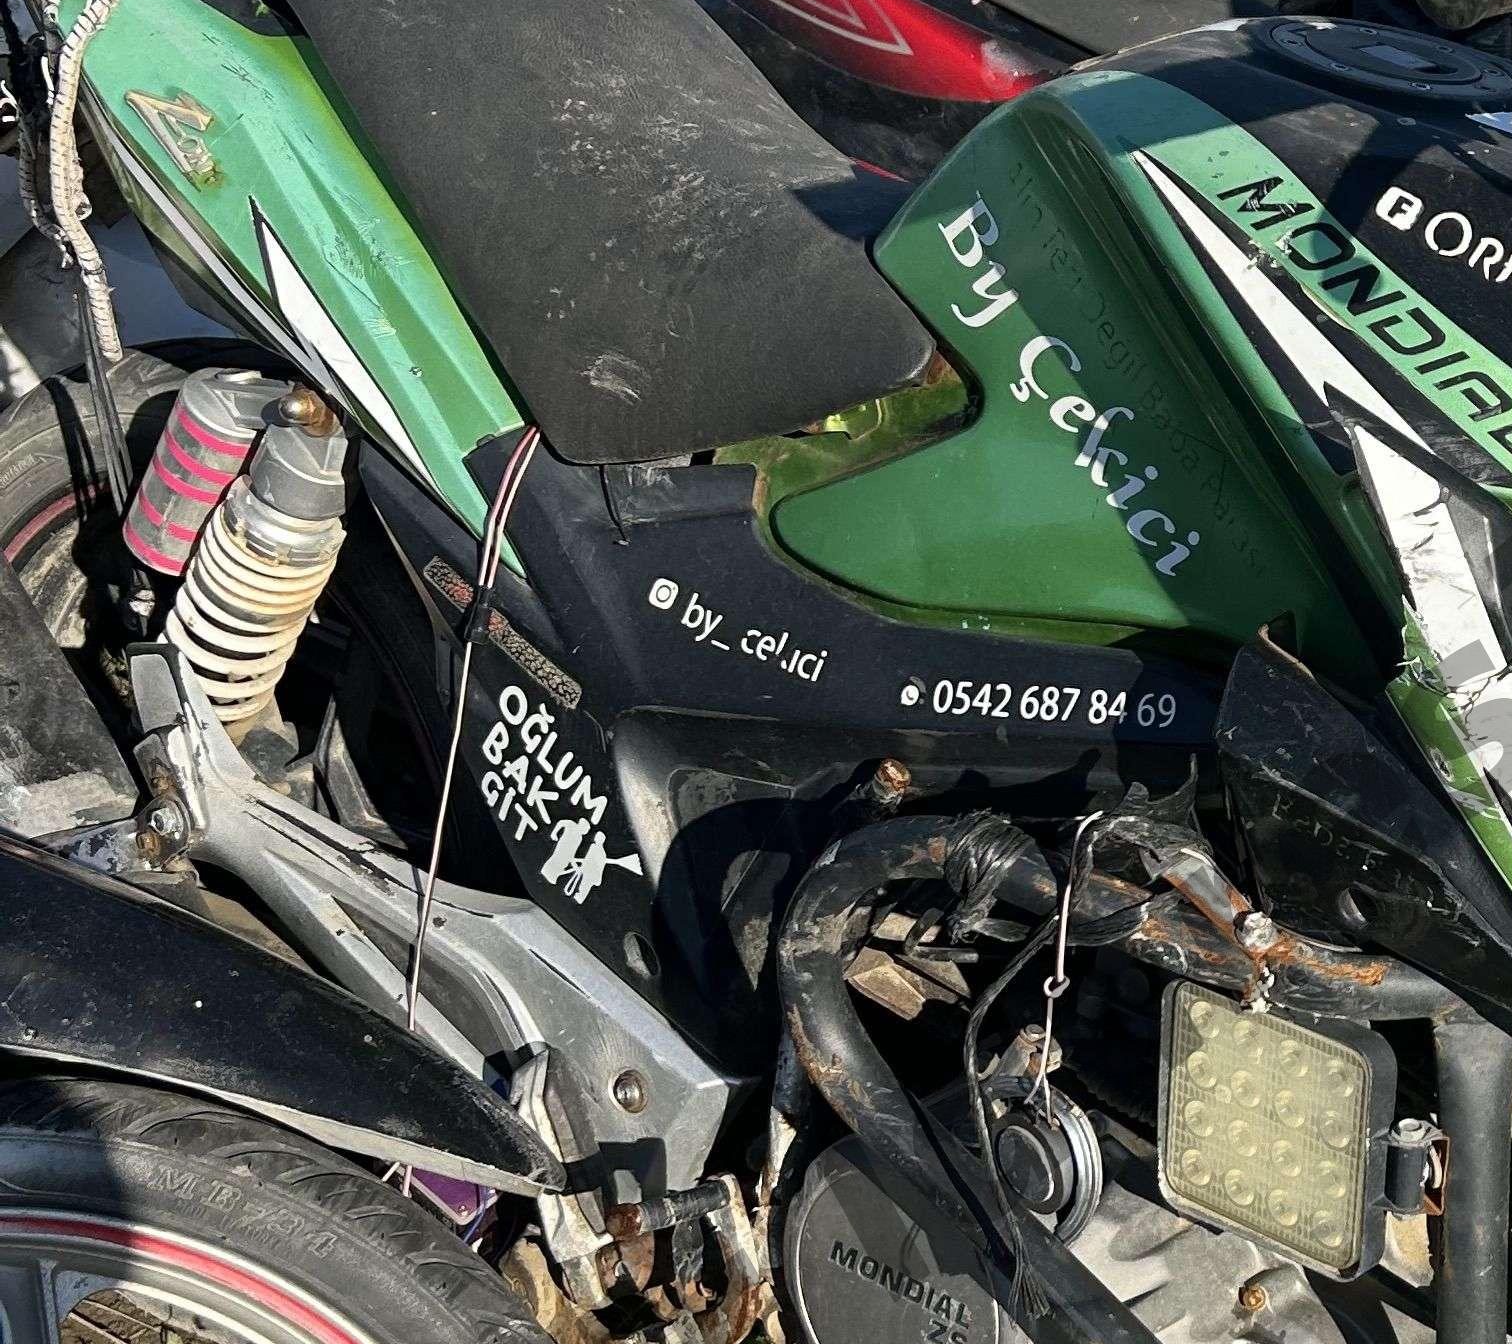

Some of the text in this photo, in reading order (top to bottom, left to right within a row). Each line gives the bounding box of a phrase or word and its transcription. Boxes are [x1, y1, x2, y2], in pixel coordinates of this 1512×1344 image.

[937, 189, 1202, 578] By Çekici
[498, 684, 608, 826] OĞLUM
[932, 678, 1177, 729] 0542 687 84 69
[482, 721, 560, 826] BAK
[828, 1239, 972, 1330] MONDIAL
